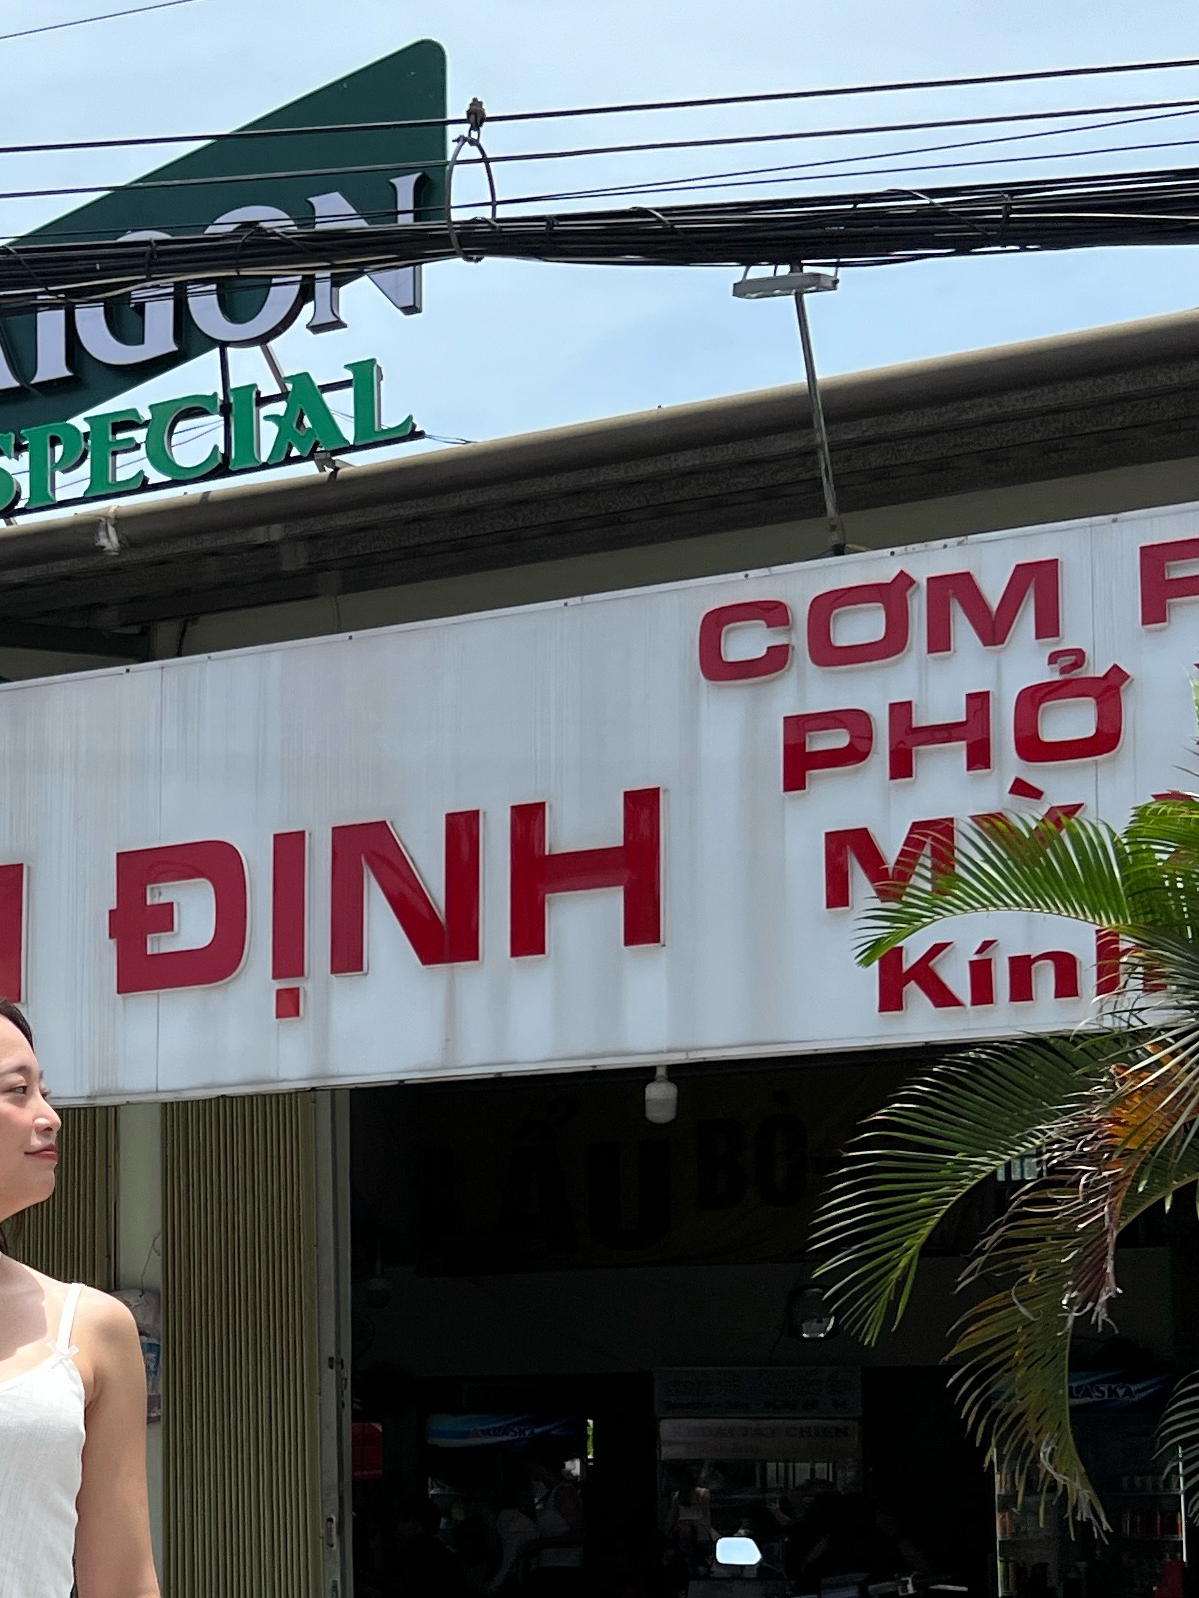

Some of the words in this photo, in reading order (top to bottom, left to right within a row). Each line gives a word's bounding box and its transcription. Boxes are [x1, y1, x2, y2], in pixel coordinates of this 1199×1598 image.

[698, 558, 1063, 683] CƠM
[783, 647, 1135, 794] PHỞ
[107, 786, 663, 1019] ĐỊNH
